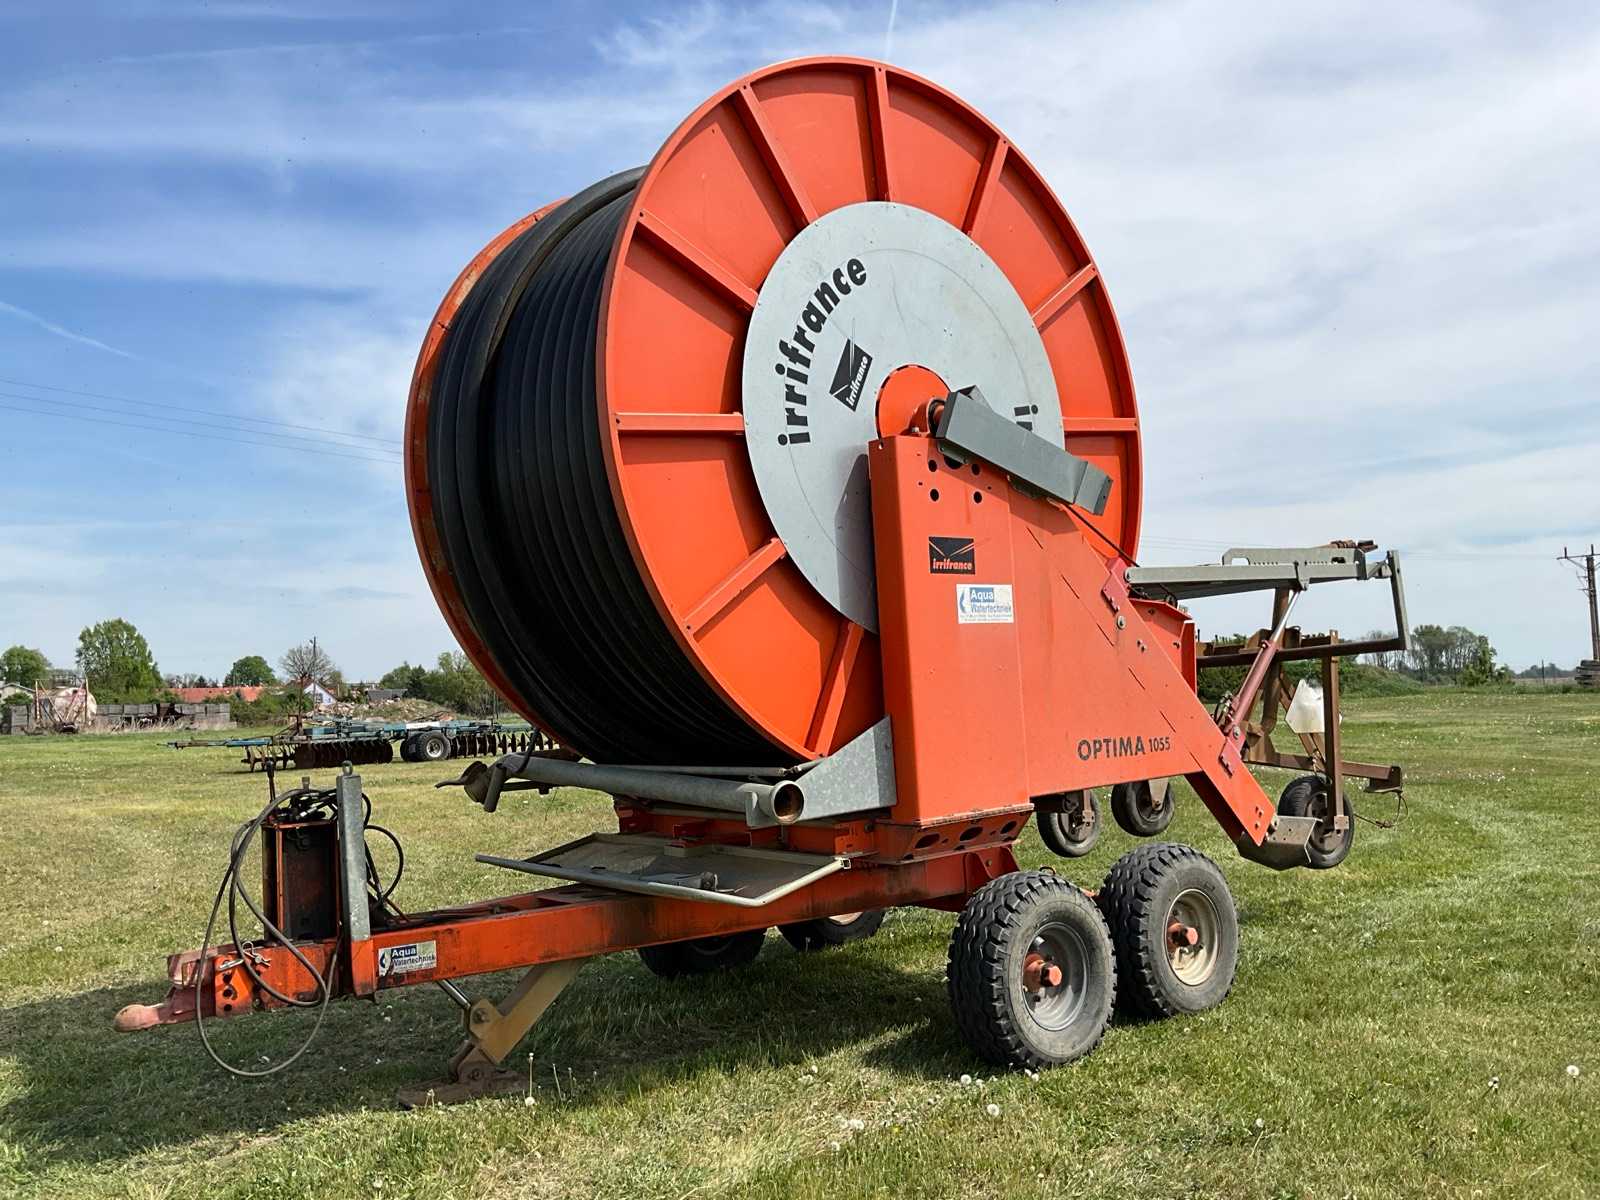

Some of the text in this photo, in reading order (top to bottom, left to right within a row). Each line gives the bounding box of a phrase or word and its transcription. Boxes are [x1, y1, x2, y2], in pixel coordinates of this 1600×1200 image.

[774, 258, 867, 446] irrifrance
[846, 356, 868, 406] irrifrance
[932, 558, 973, 570] irrifrance
[970, 589, 994, 601] Aqua
[1077, 735, 1171, 761] OPTIMA 1055
[391, 947, 417, 958] Aqua
